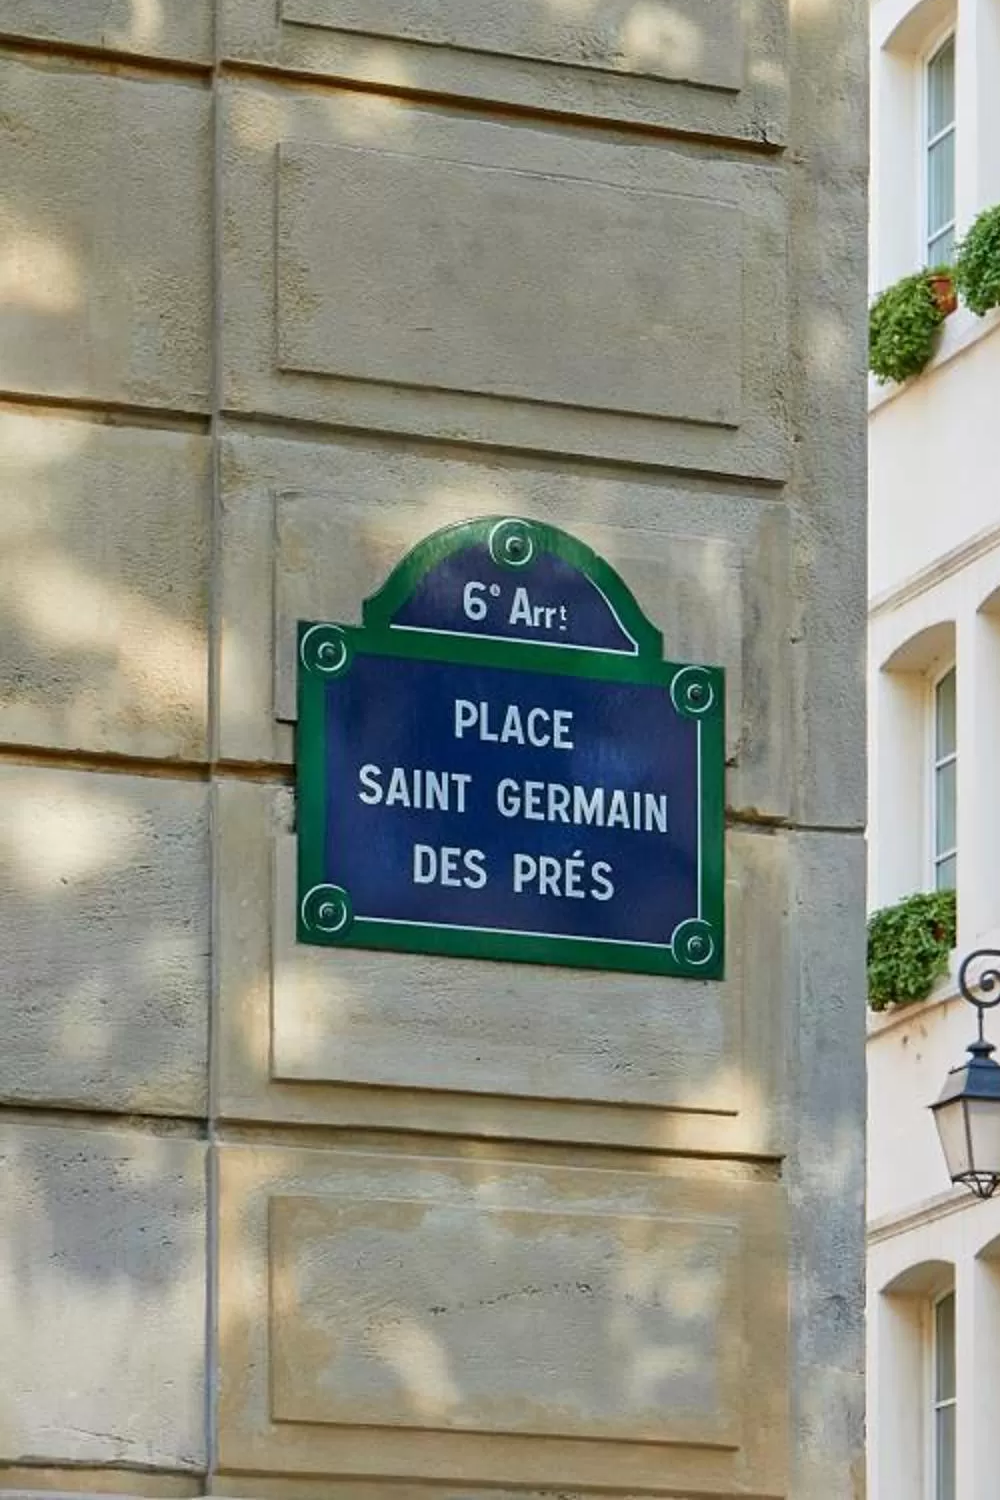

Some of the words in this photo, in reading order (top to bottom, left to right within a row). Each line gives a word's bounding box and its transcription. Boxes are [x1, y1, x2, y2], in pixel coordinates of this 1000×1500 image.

[455, 699, 575, 749] PLACE
[358, 763, 472, 813] SAINT
[497, 777, 668, 833] GERMAIN
[413, 843, 488, 888] DES
[513, 850, 615, 901] PRÉS
